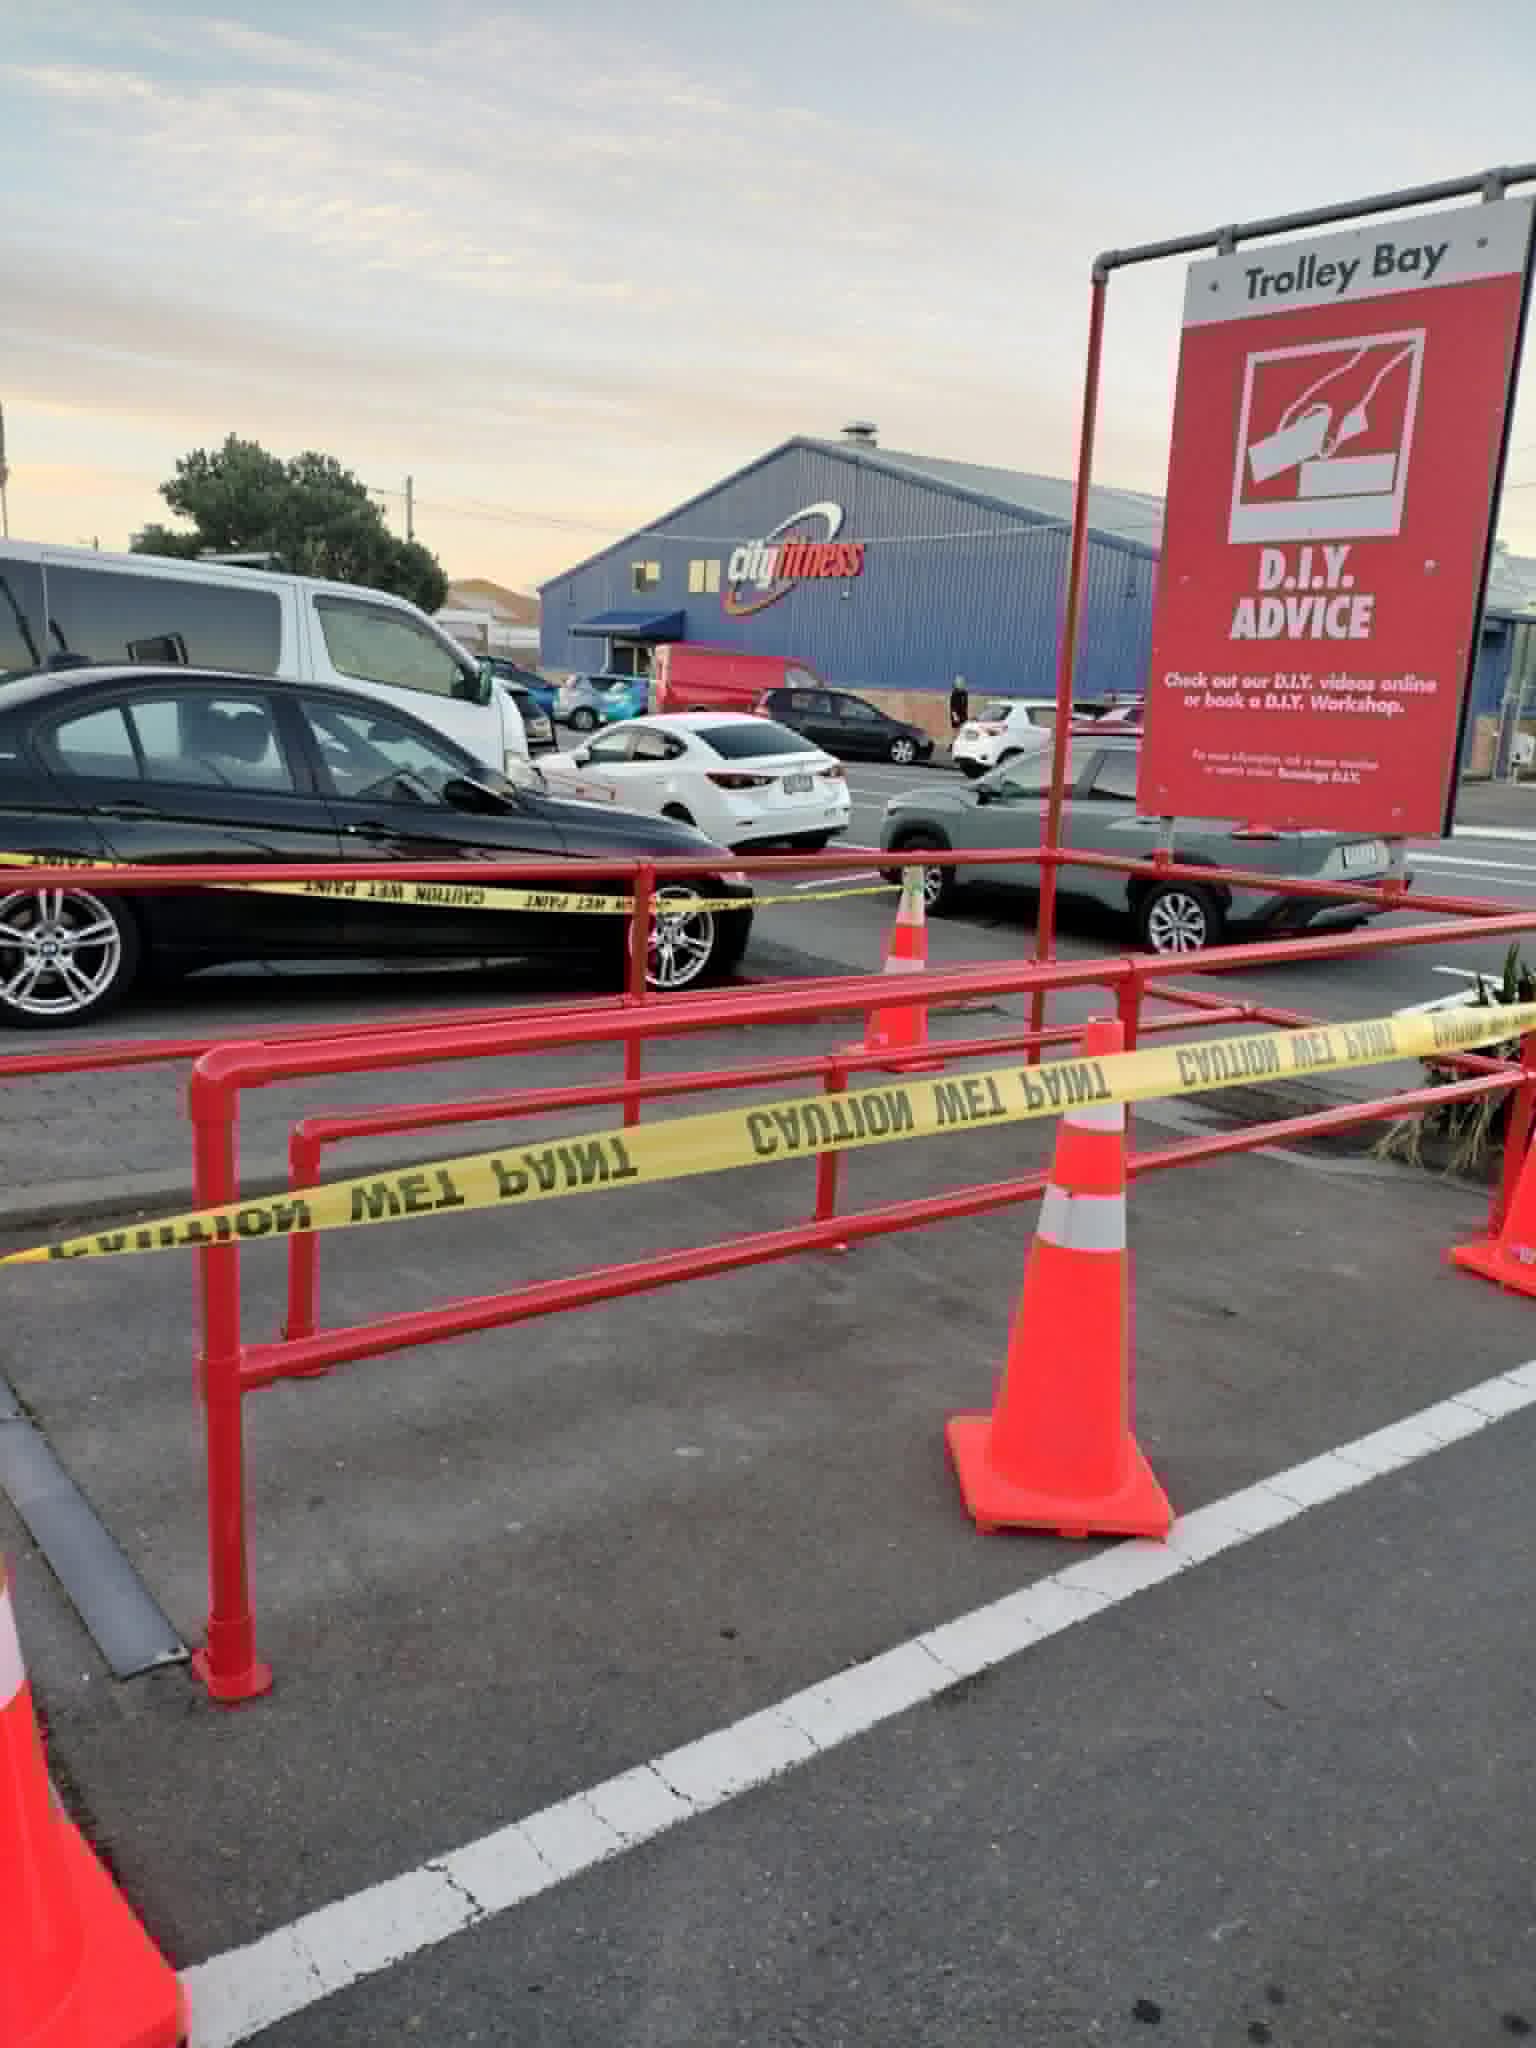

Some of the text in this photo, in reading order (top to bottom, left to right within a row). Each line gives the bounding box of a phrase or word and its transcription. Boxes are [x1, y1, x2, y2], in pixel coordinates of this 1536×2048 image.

[1246, 242, 1448, 300] Trolley Bay
[1258, 544, 1355, 590] D.I.Y.
[1230, 594, 1375, 640] ADVICE
[1164, 672, 1437, 693] Check out our D.I.Y. videos online
[1184, 691, 1405, 719] or book a D.I.Y. Workshop.
[303, 879, 485, 906] CAUTION WET PAINT
[523, 894, 569, 914] PAINT
